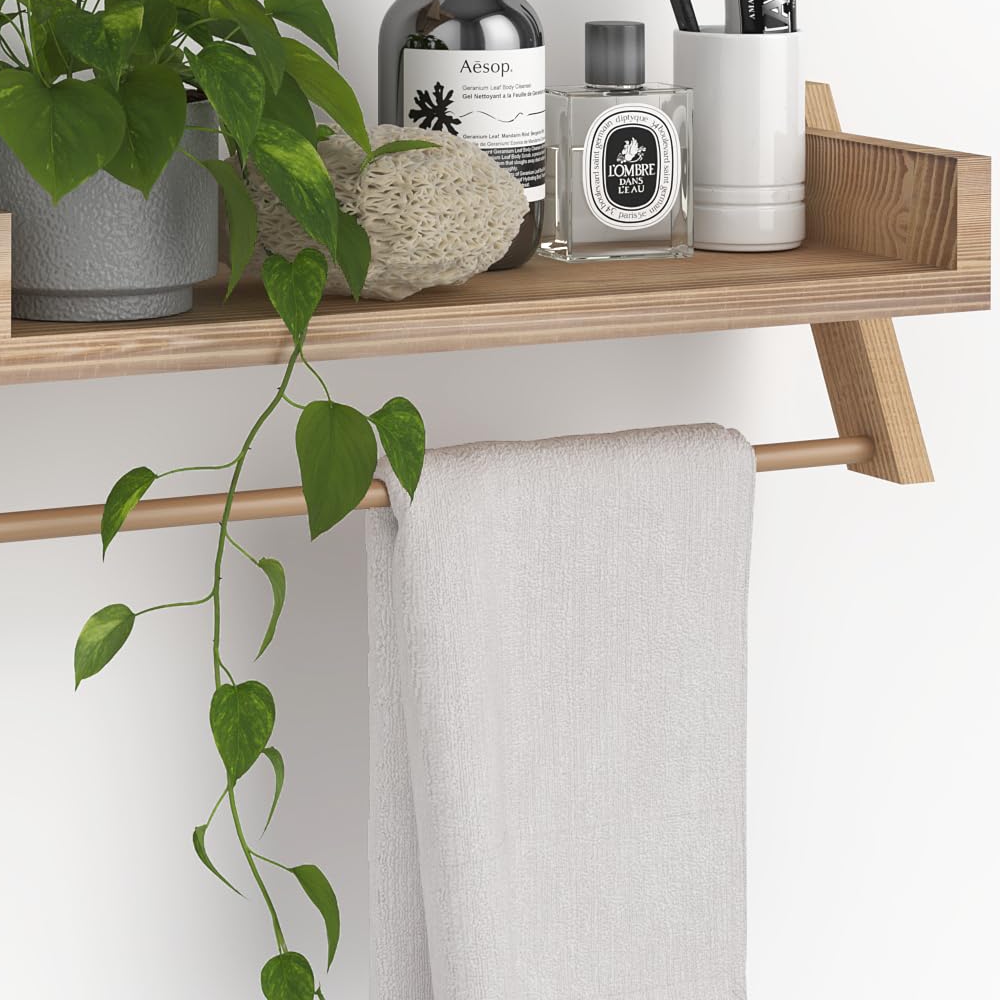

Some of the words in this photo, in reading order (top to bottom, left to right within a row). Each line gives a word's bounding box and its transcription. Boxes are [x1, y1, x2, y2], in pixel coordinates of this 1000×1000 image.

[615, 114, 649, 123] diptyque
[595, 120, 613, 149] germain
[608, 163, 656, 177] L'OMBRE
[663, 165, 671, 184] saint
[619, 177, 644, 185] DANS
[618, 185, 645, 194] L'EAU
[649, 185, 668, 214] germain
